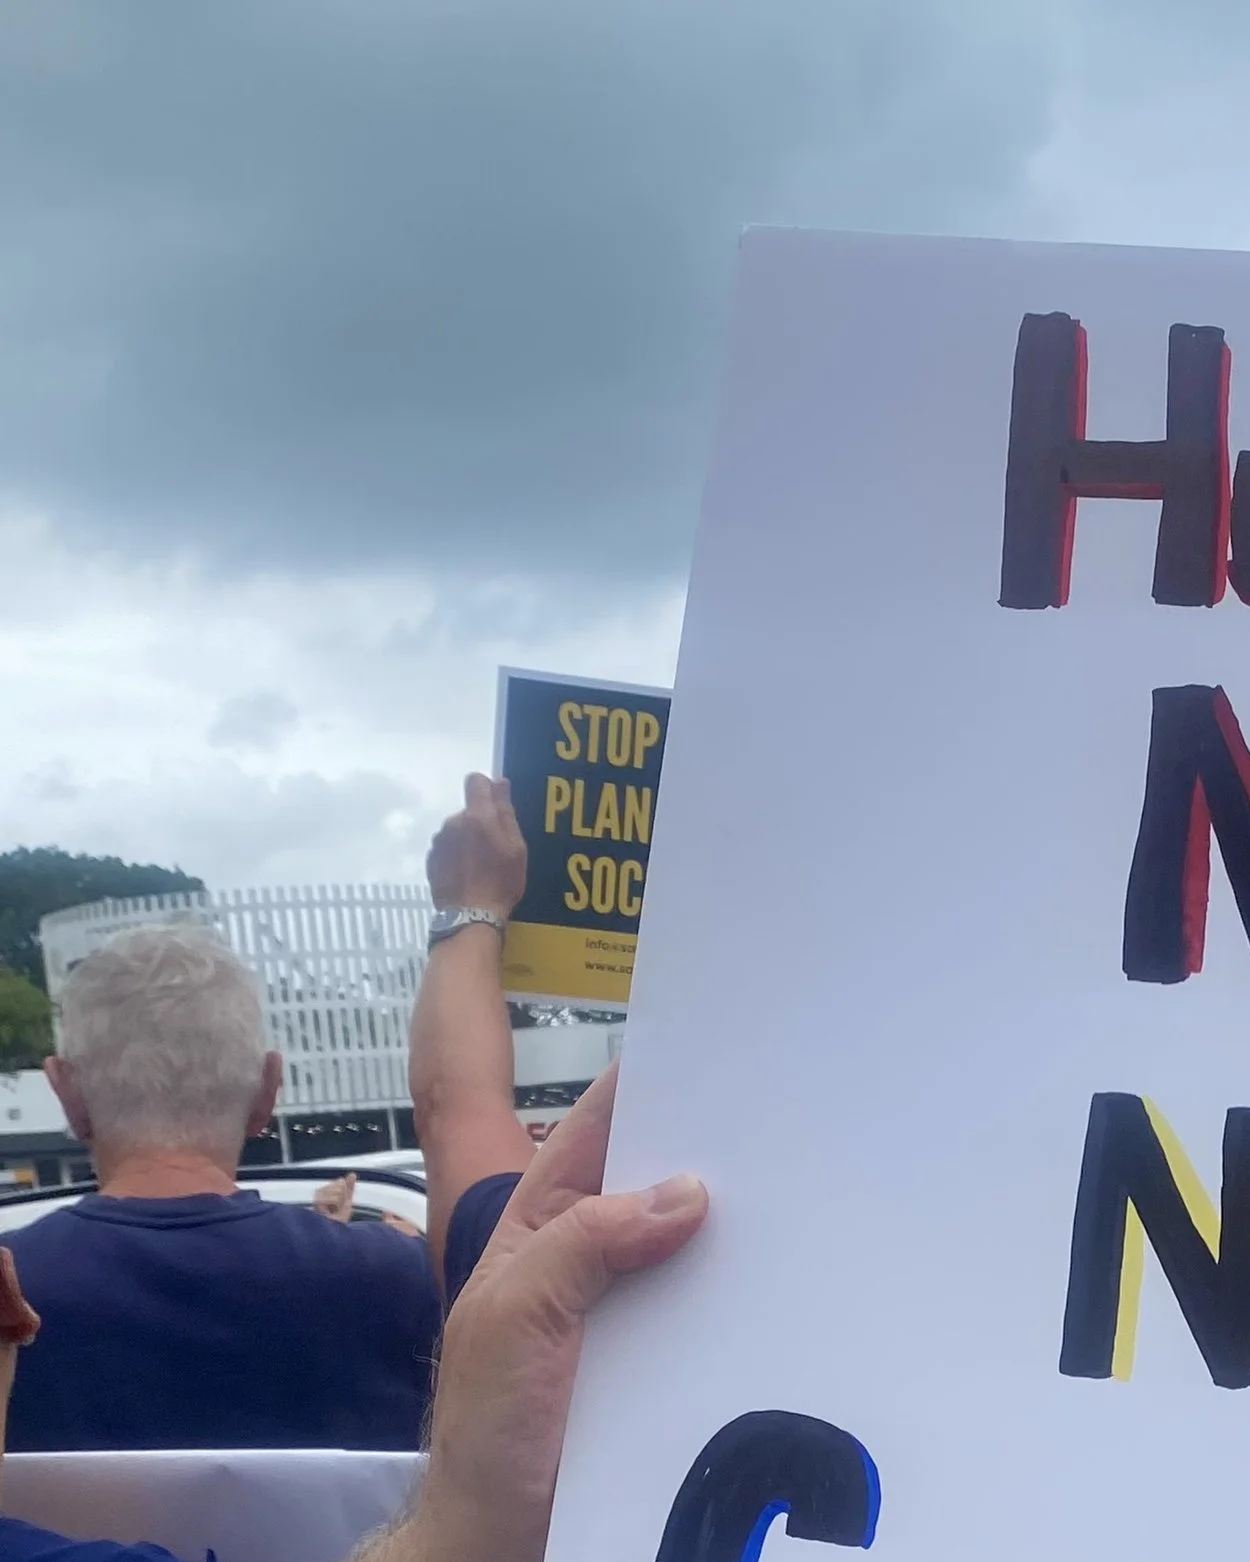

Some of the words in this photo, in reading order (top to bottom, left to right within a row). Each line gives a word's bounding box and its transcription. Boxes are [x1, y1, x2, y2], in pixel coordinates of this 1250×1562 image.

[555, 700, 660, 769] STOP
[545, 775, 653, 844] PLAN
[564, 853, 643, 917] SOC
